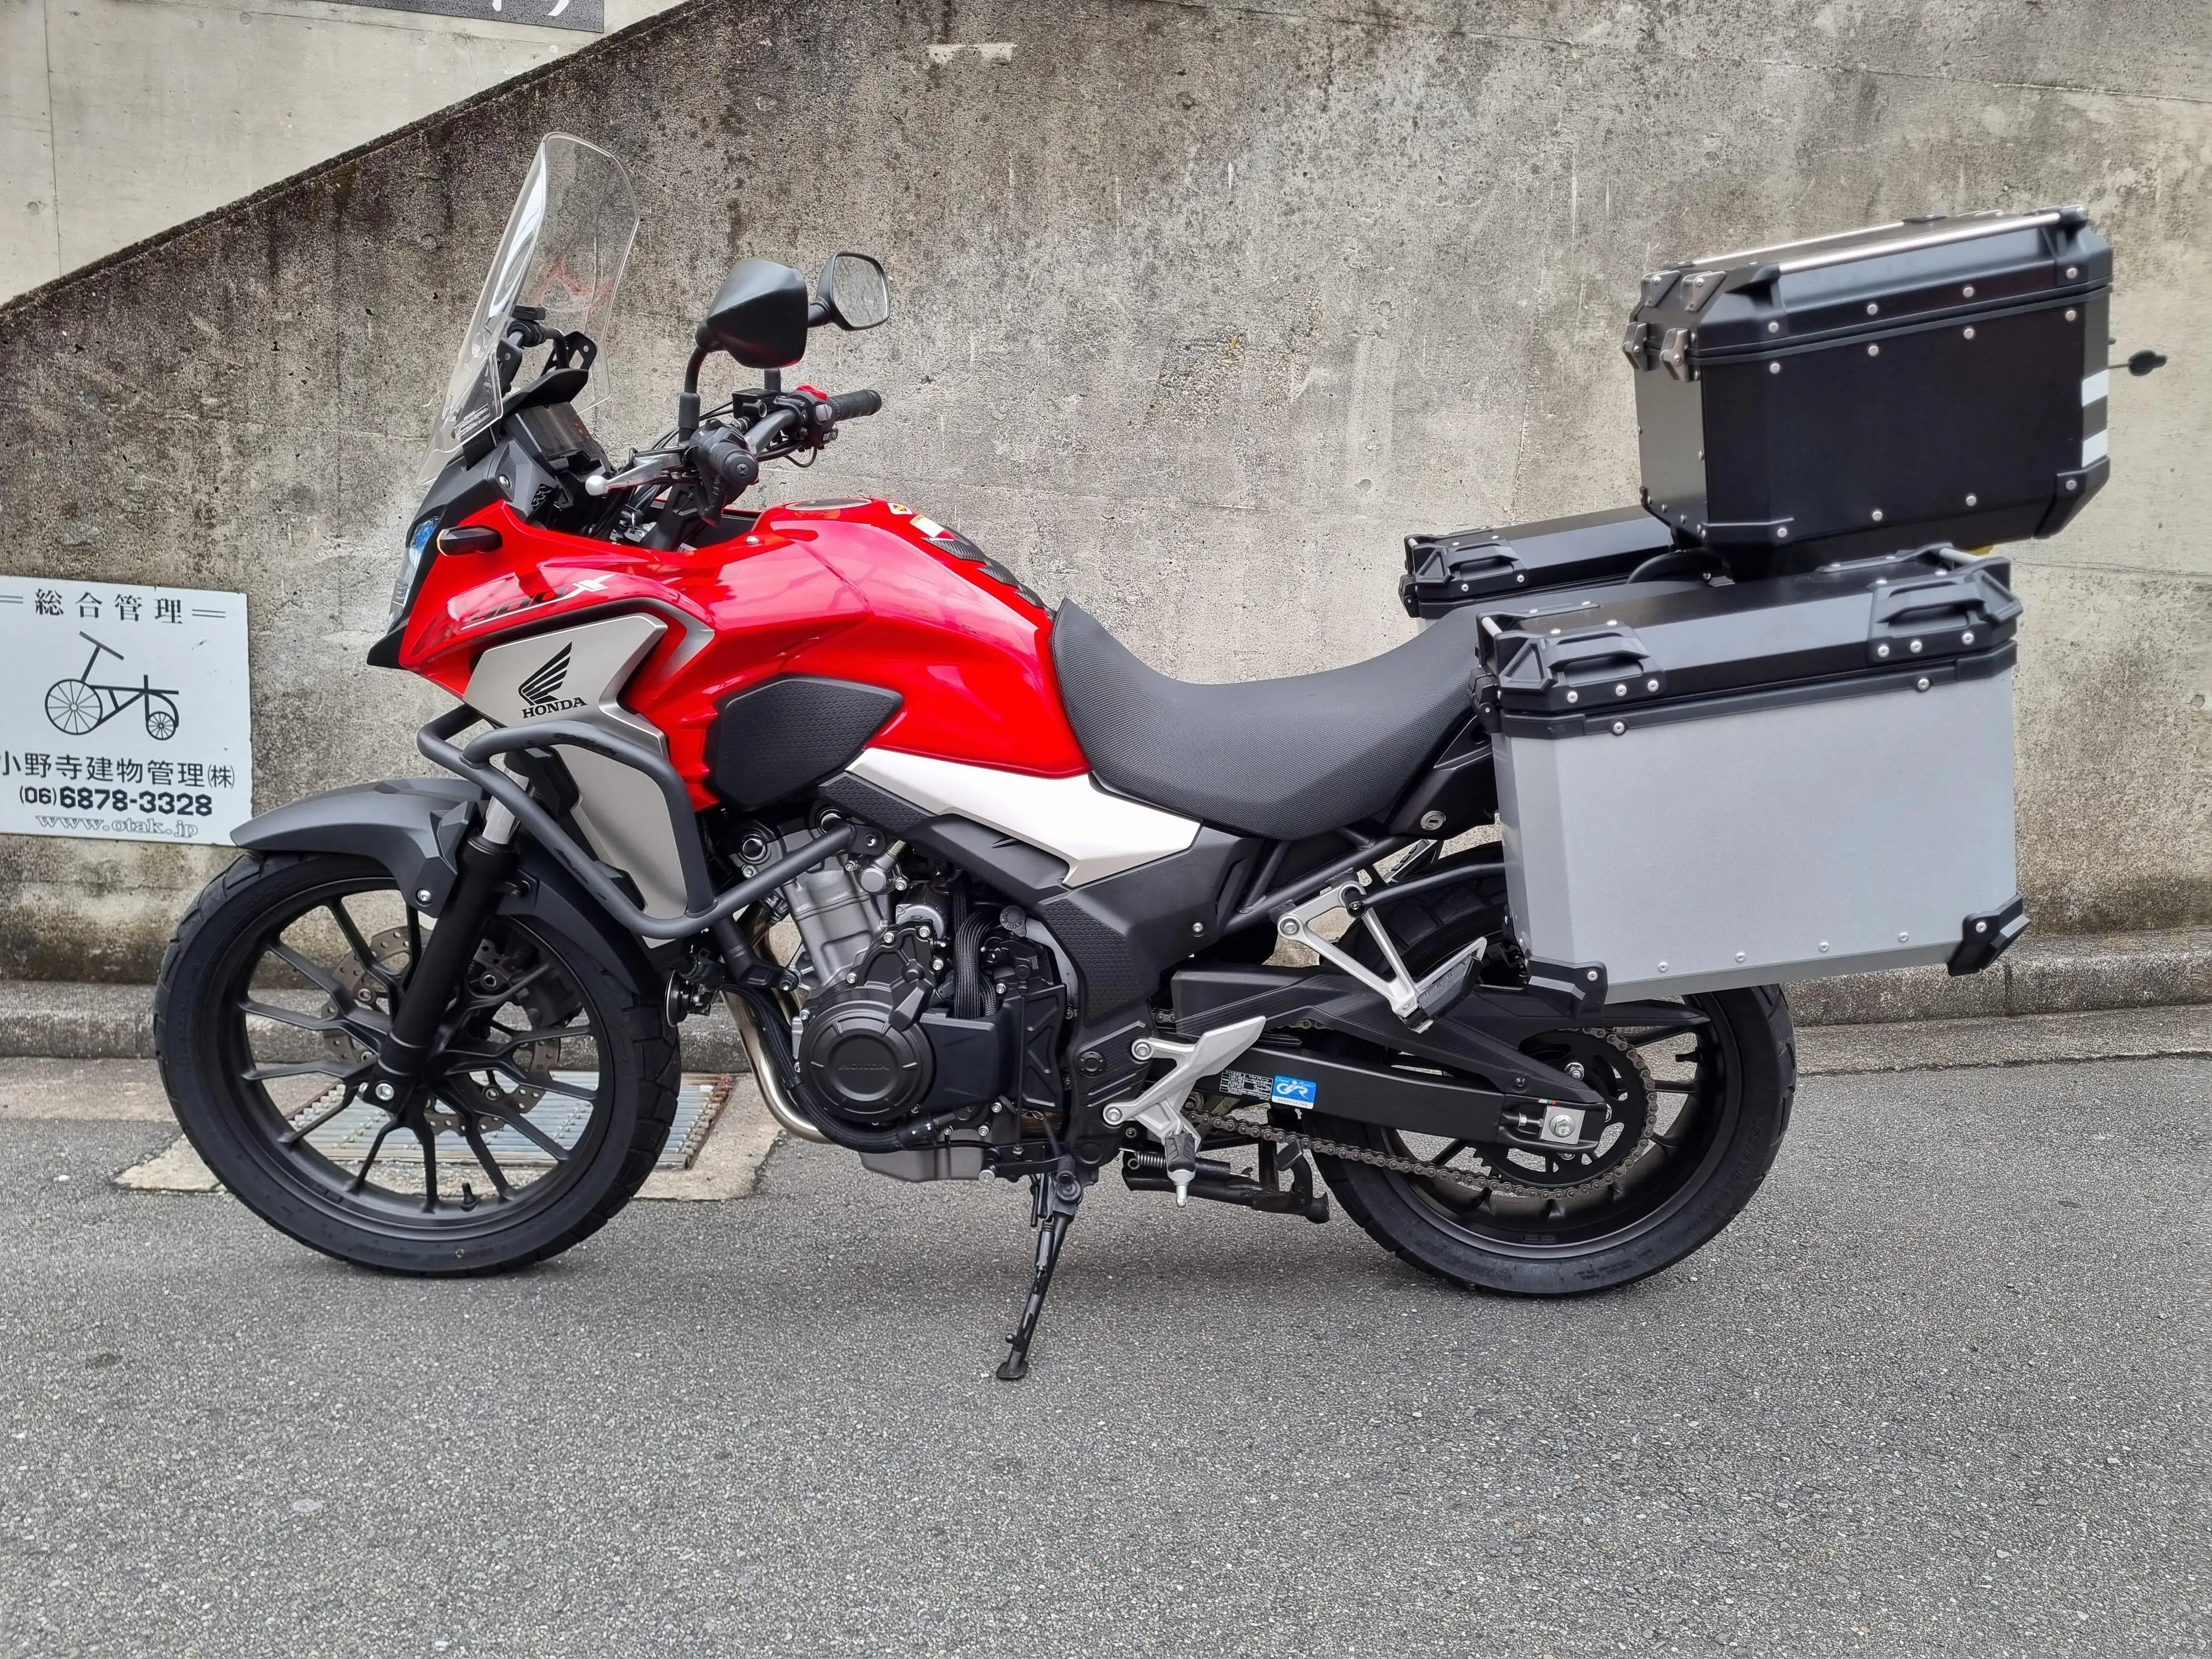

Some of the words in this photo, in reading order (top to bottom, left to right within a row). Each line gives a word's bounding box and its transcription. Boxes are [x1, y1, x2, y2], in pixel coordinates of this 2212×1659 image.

[35, 588, 183, 624] 総合管理
[522, 697, 588, 719] HONDA
[19, 785, 213, 816] (06)6878-3328
[36, 815, 199, 838] www.otak.jp
